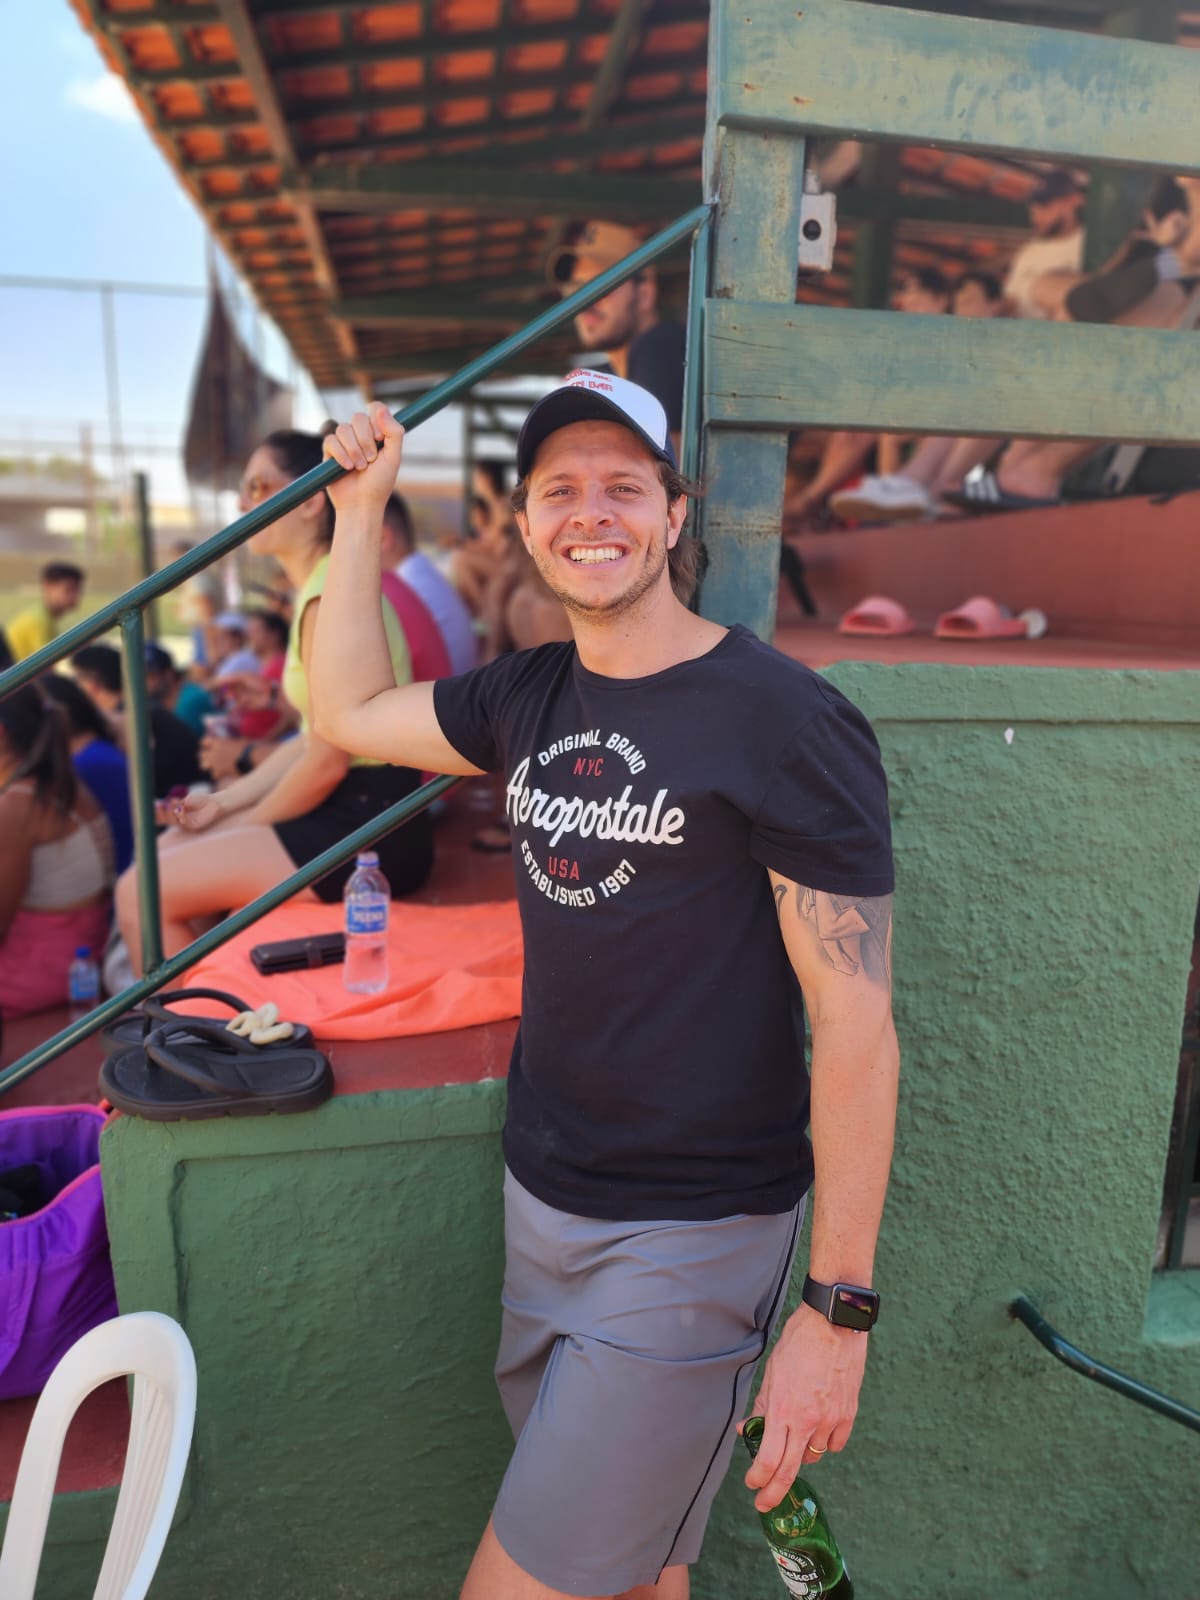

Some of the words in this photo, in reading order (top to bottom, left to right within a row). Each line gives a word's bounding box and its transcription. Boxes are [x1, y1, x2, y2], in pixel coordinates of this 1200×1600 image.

[537, 729, 601, 766] ORIGINAL
[605, 733, 647, 775] BRAND
[573, 757, 604, 777] NYC
[506, 756, 685, 848] Aeropostale
[521, 839, 596, 907] ESTABLISHED
[598, 858, 637, 898] 1987
[548, 856, 580, 881] USA
